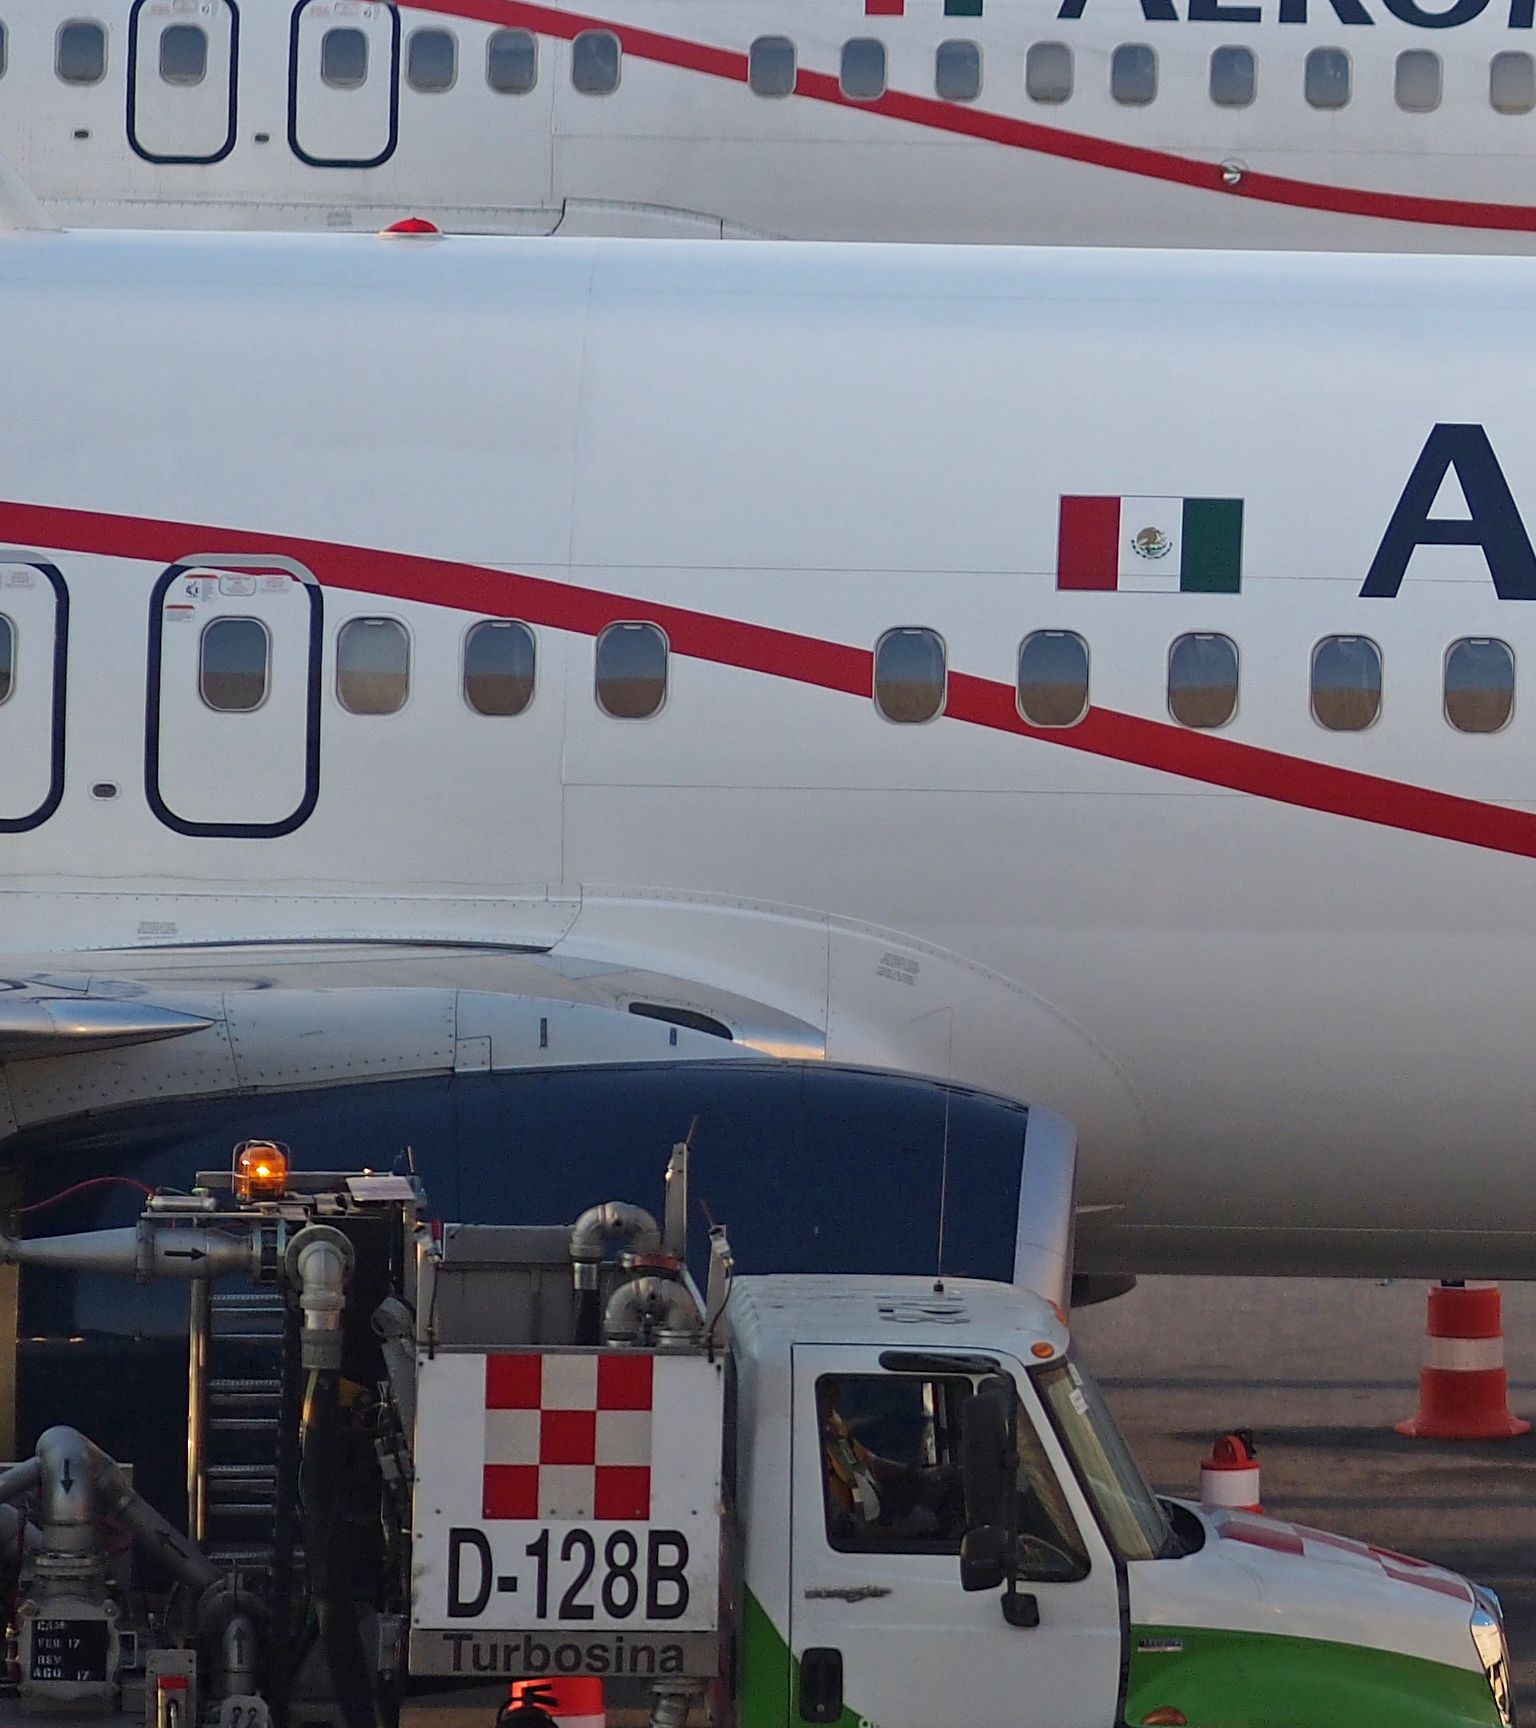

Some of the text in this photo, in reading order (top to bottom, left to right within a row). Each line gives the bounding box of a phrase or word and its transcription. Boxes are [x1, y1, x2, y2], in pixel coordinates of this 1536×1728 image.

[447, 1528, 690, 1620] D-128B
[68, 1638, 81, 1649] 17
[442, 1633, 685, 1673] Turbosina
[77, 1670, 90, 1681] 17
